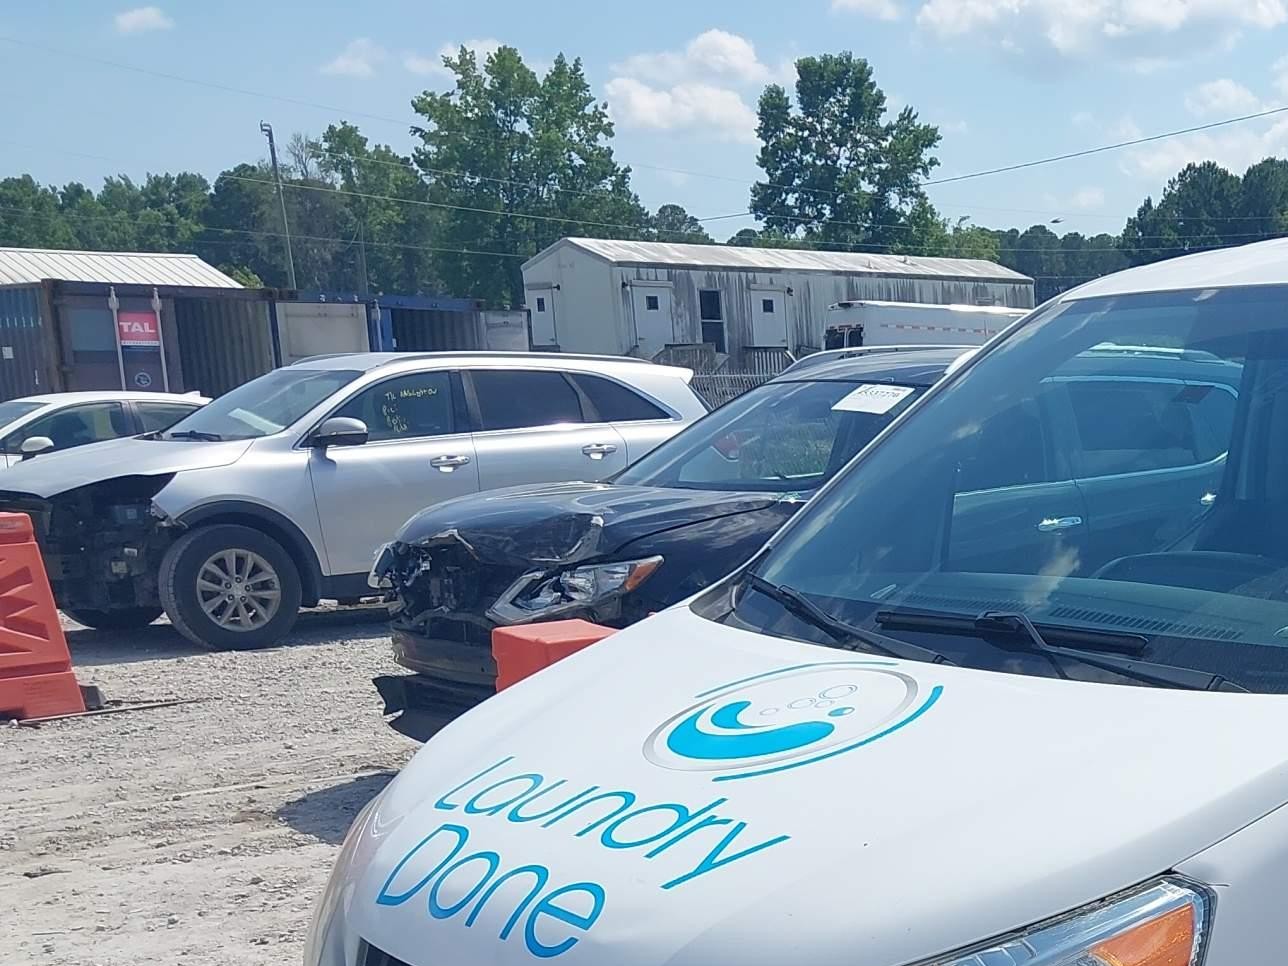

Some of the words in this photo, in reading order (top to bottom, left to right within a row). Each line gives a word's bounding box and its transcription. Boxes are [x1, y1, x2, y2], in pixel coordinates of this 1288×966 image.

[119, 321, 156, 333] TAL
[433, 755, 791, 890] Laundry
[376, 824, 606, 959] Done
